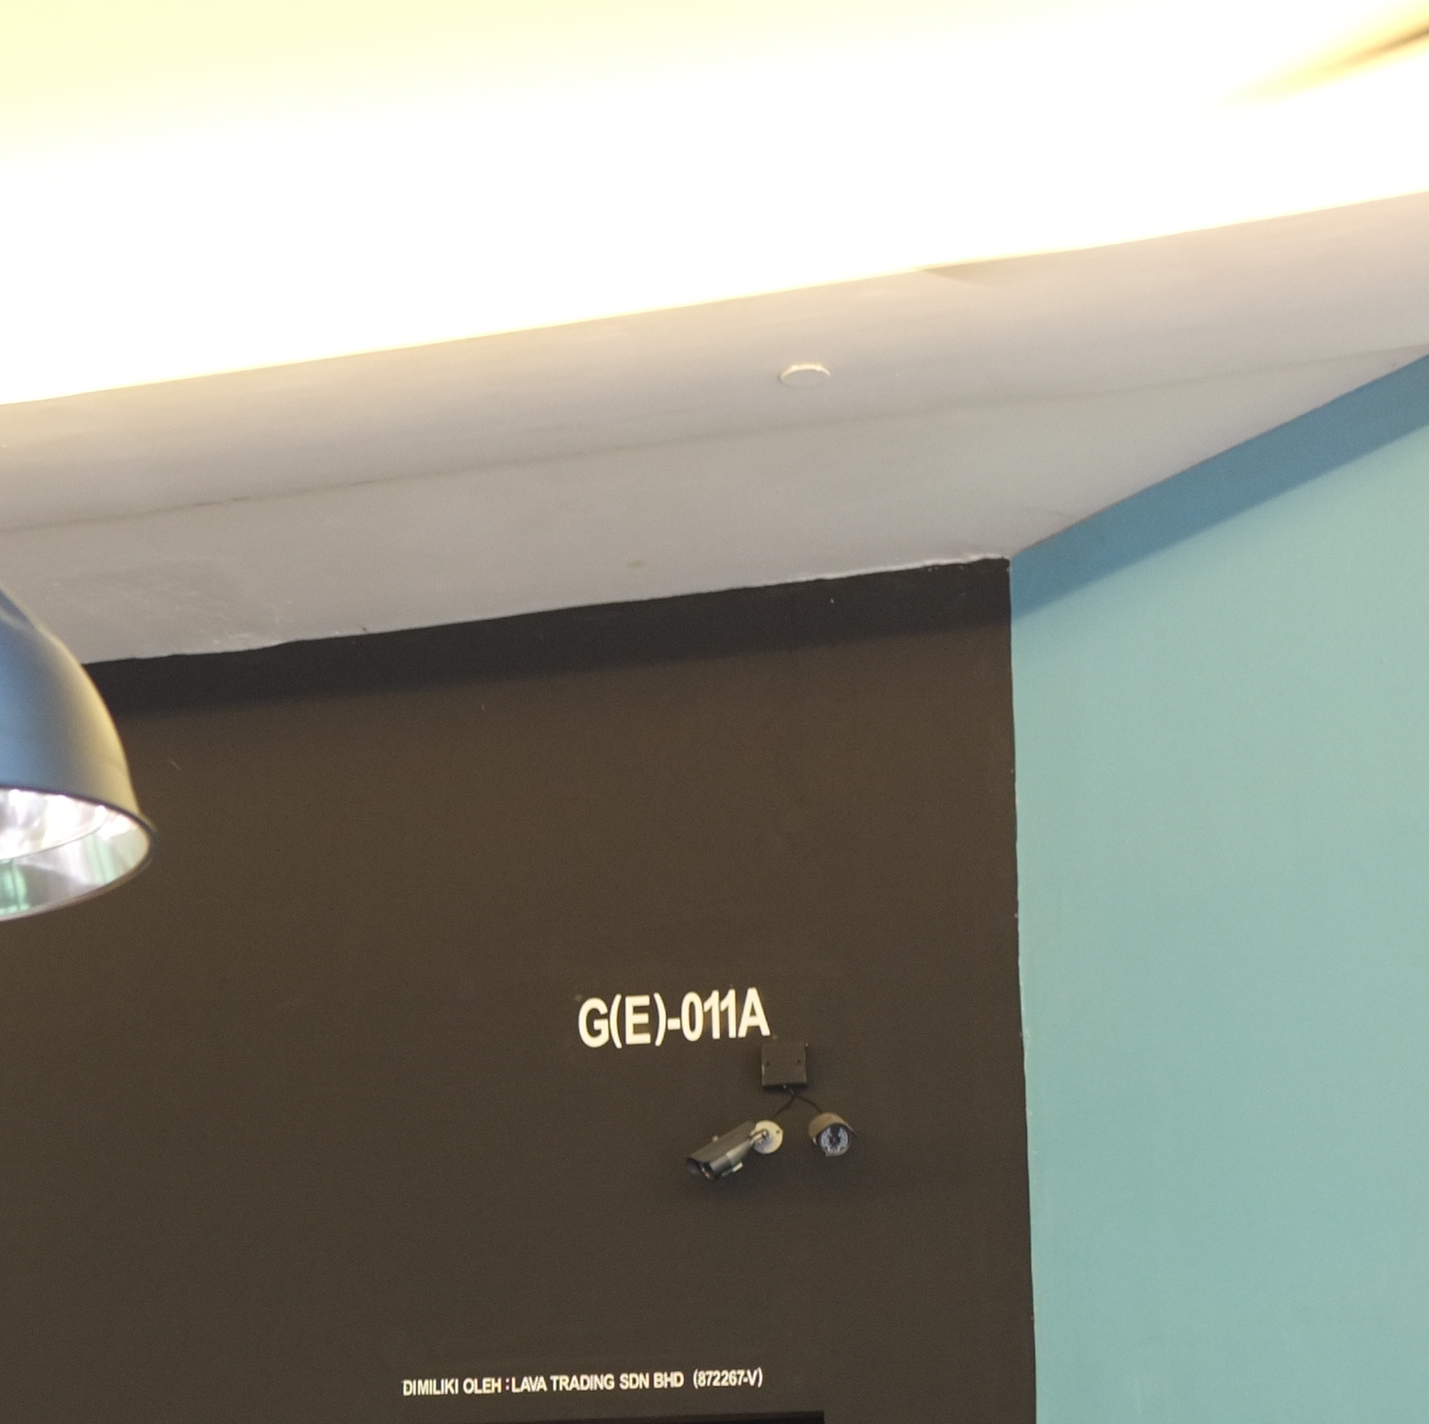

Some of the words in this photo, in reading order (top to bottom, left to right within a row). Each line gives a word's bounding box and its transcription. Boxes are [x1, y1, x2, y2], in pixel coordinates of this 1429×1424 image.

[578, 987, 770, 1049] G(E)-011A
[403, 1377, 459, 1396] DIMILIKI
[463, 1376, 502, 1394] OLEH
[550, 1373, 615, 1391] TRADING
[619, 1372, 650, 1390] SDN
[653, 1371, 684, 1389] BHD
[693, 1367, 763, 1389] (872267-V)
